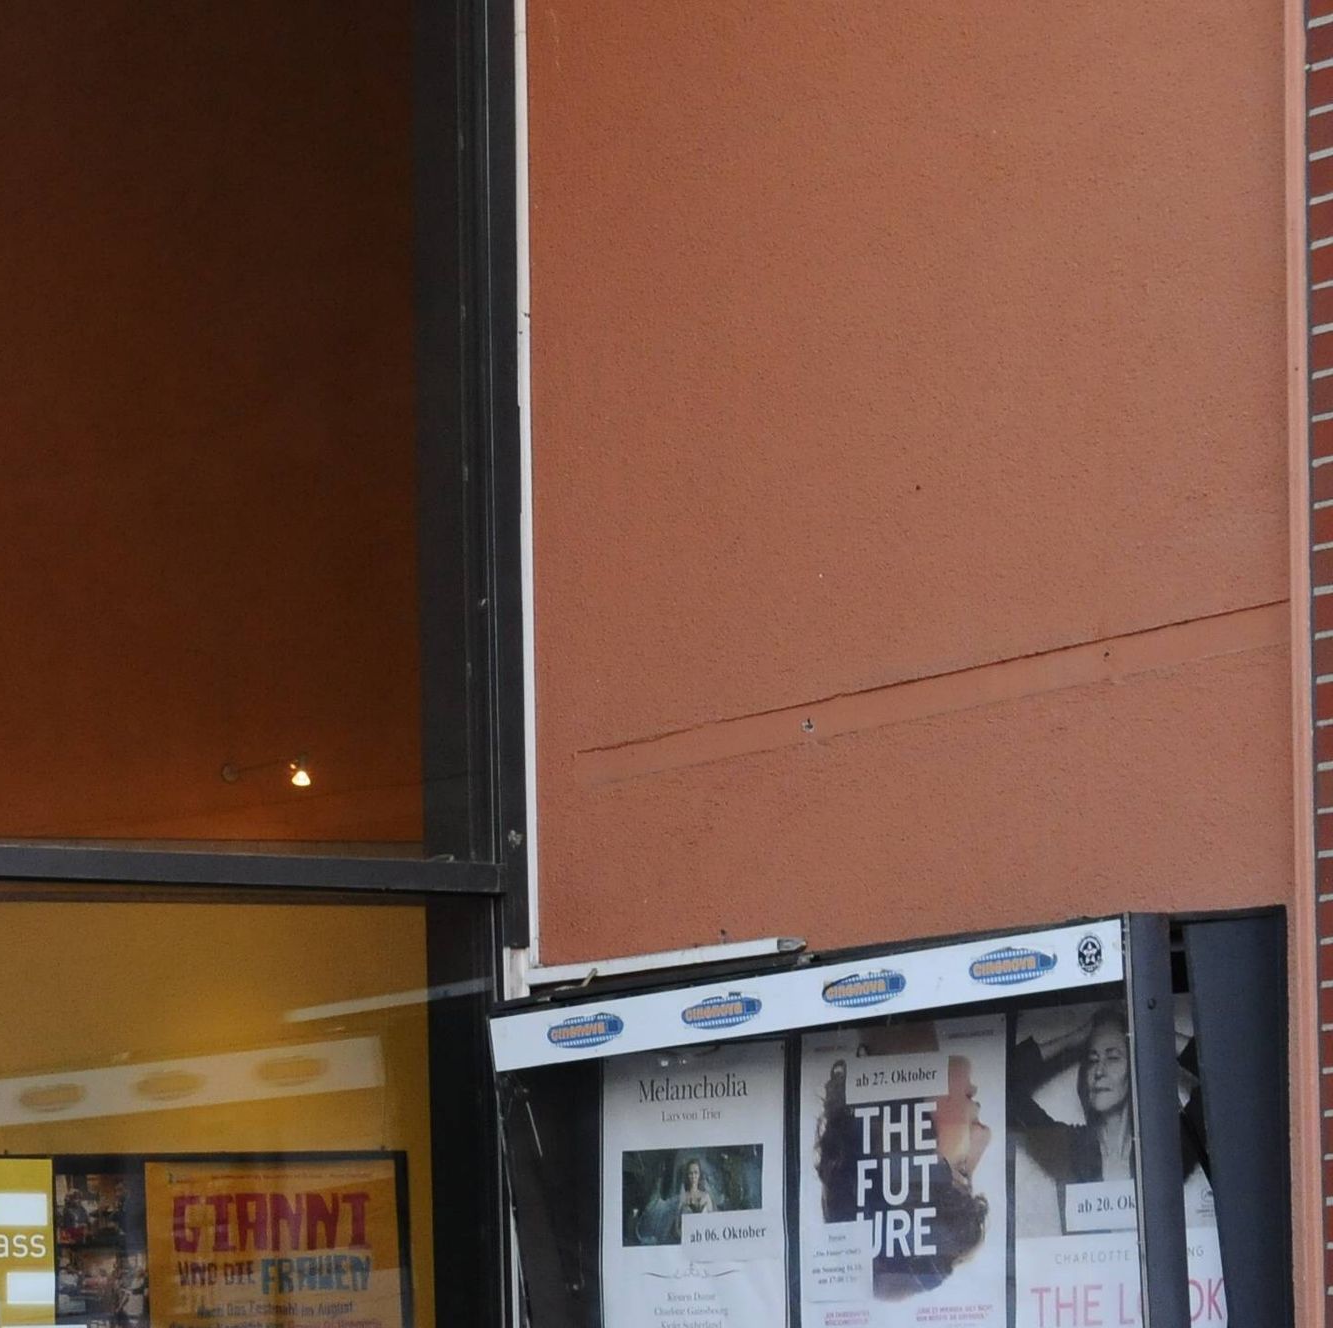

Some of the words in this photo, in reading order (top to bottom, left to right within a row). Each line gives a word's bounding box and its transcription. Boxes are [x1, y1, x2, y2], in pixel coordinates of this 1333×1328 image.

[638, 1073, 748, 1103] Melancholia
[856, 1076, 869, 1088] ab
[873, 1072, 887, 1086] 27.
[891, 1068, 938, 1084] Oktober
[701, 1108, 722, 1121] Trier
[854, 1101, 937, 1155] THE
[856, 1154, 938, 1208] FUT
[1077, 1199, 1092, 1214] ab
[1096, 1196, 1114, 1211] 20.
[172, 1192, 372, 1254] GIANNI
[690, 1231, 703, 1243] ab
[704, 1229, 720, 1242] 06.
[722, 1226, 767, 1241] Oktober
[1055, 1252, 1131, 1265] CHARLOTTE
[176, 1260, 218, 1286] UND
[223, 1260, 256, 1286] DIE
[261, 1254, 373, 1294] FRAUEN
[1030, 1283, 1104, 1328] THE
